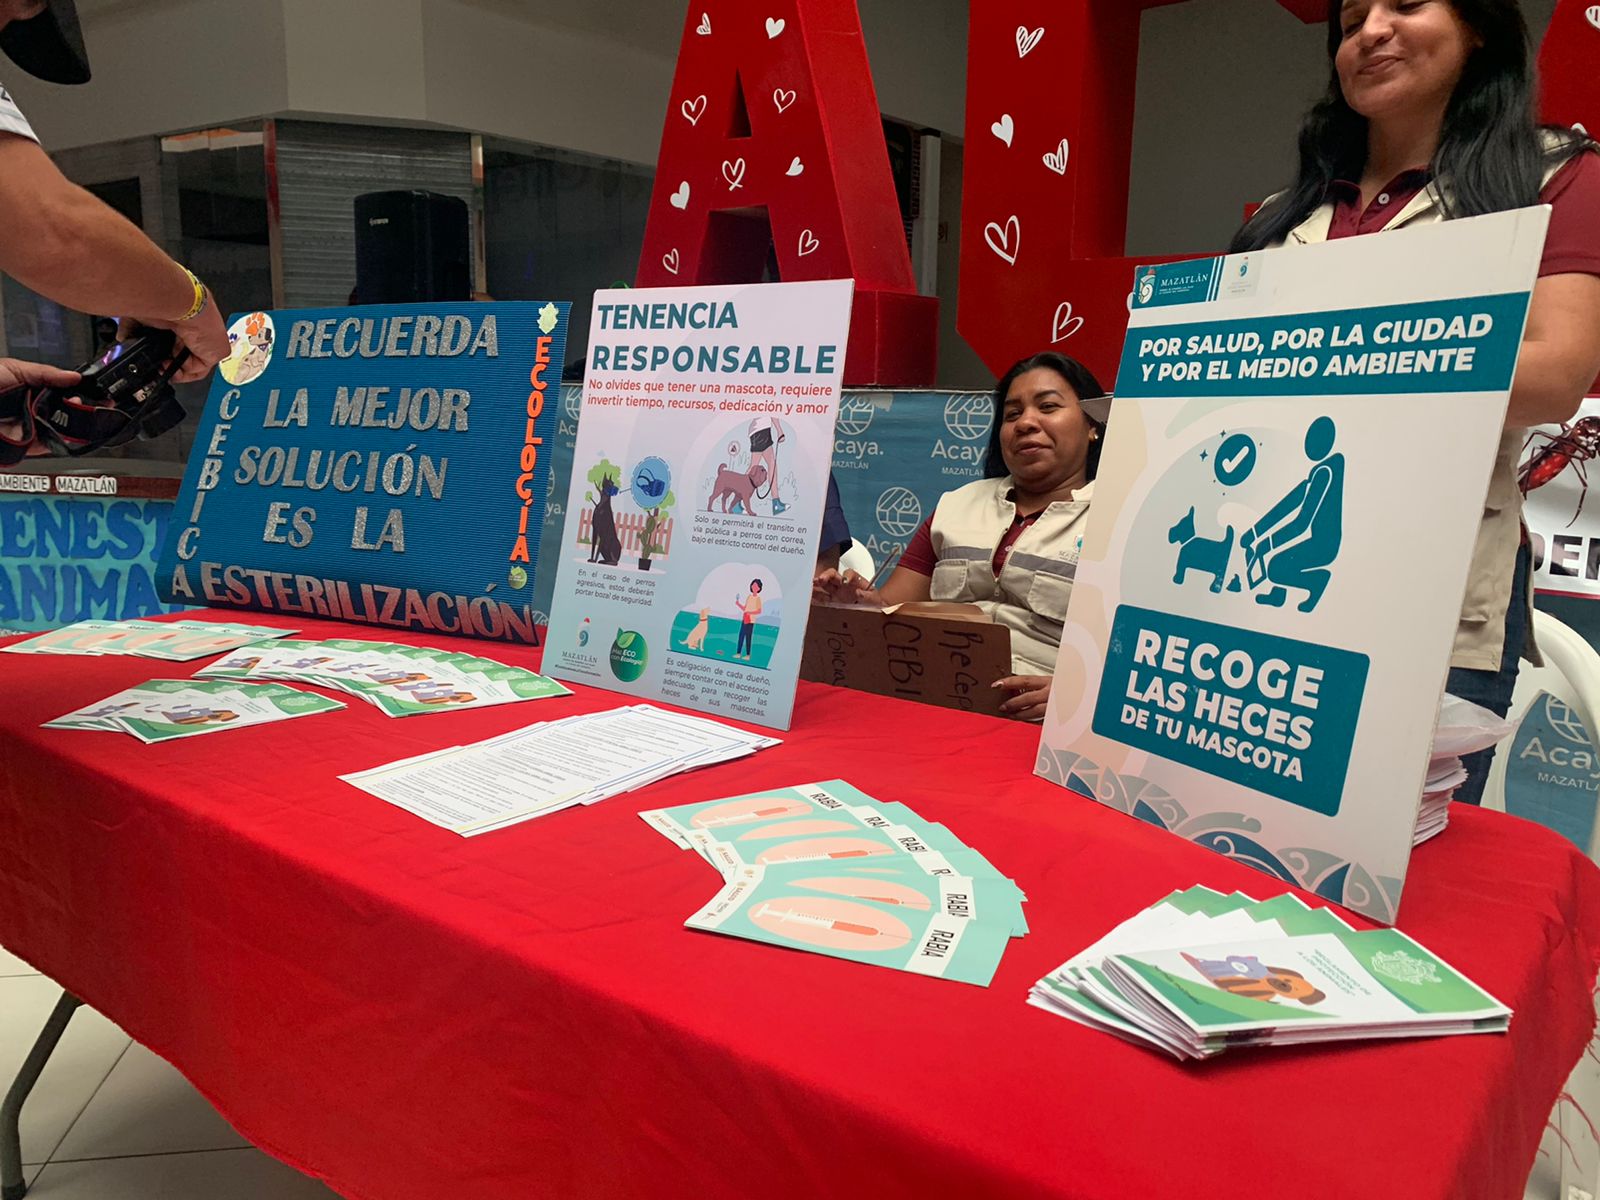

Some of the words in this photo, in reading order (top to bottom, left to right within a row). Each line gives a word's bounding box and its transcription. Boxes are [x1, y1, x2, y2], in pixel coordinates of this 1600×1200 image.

[1160, 273, 1209, 287] MAZATLÁN
[598, 302, 738, 329] TENENCIA
[286, 314, 499, 358] RECUERDA
[1139, 338, 1182, 357] POR
[1186, 332, 1264, 355] SALUD,
[1271, 328, 1325, 350] POR
[1330, 324, 1364, 347] LA
[1373, 313, 1493, 345] CIUDAD
[592, 345, 837, 374] RESPONSABLE
[1142, 363, 1155, 382] Y
[1158, 361, 1202, 381] POR
[1206, 360, 1232, 380] EL
[1238, 355, 1318, 379] MEDIO
[1322, 347, 1476, 377] AMBIENTE
[589, 379, 603, 389] No
[606, 379, 641, 391] olvides
[644, 383, 664, 393] que
[668, 382, 696, 392] tener
[700, 384, 720, 393] una
[724, 384, 777, 396] mascota,
[780, 384, 833, 397] requiere
[263, 387, 308, 428] LA
[331, 386, 471, 431] MEJOR
[588, 394, 623, 406] invertir
[626, 395, 665, 409] tiempo,
[667, 399, 717, 411] recursos,
[719, 399, 782, 412] dedicación
[785, 403, 794, 415] y
[795, 403, 829, 414] amor
[834, 439, 884, 459] caya.
[931, 439, 986, 466] Acay
[57, 476, 116, 493] MAZATLÁN
[234, 443, 447, 499] SOLUCIÓN
[263, 502, 317, 547] ES
[351, 506, 405, 551] LA
[694, 515, 709, 523] Solo
[722, 518, 754, 528] permitirá
[691, 535, 706, 544] bajo
[714, 538, 741, 548] estricto
[741, 541, 767, 551] control
[768, 543, 780, 552] del
[705, 526, 730, 536] pública
[740, 531, 762, 540] perros
[781, 536, 806, 546] correa,
[0, 563, 184, 624] ANIMA
[575, 588, 594, 596] portar
[603, 573, 617, 581] caso
[635, 579, 656, 587] perros
[609, 584, 625, 592] estos
[628, 586, 654, 596] deberán
[200, 561, 538, 644] ESTERILIZACIÓN
[562, 650, 598, 663] MAZATLÁN
[623, 649, 636, 657] ECO
[664, 668, 691, 679] siempre
[692, 674, 714, 684] contar
[714, 679, 728, 687] con
[736, 683, 769, 696] accesorio
[666, 658, 674, 666] Es
[676, 660, 711, 673] obligación
[714, 667, 723, 676] de
[726, 670, 743, 679] cada
[1133, 628, 1325, 709] RECOGE
[661, 687, 681, 697] heces
[708, 698, 720, 707] sus
[663, 678, 695, 690] adecuado
[701, 686, 717, 695] para
[724, 691, 751, 703] recoger
[757, 697, 768, 706] las
[1125, 670, 1187, 712] LAS
[1194, 688, 1314, 751] HECES
[1120, 704, 1150, 730] DE
[1155, 714, 1183, 740] TU
[1186, 724, 1304, 782] MASCOTA
[921, 929, 955, 958] RABIA
